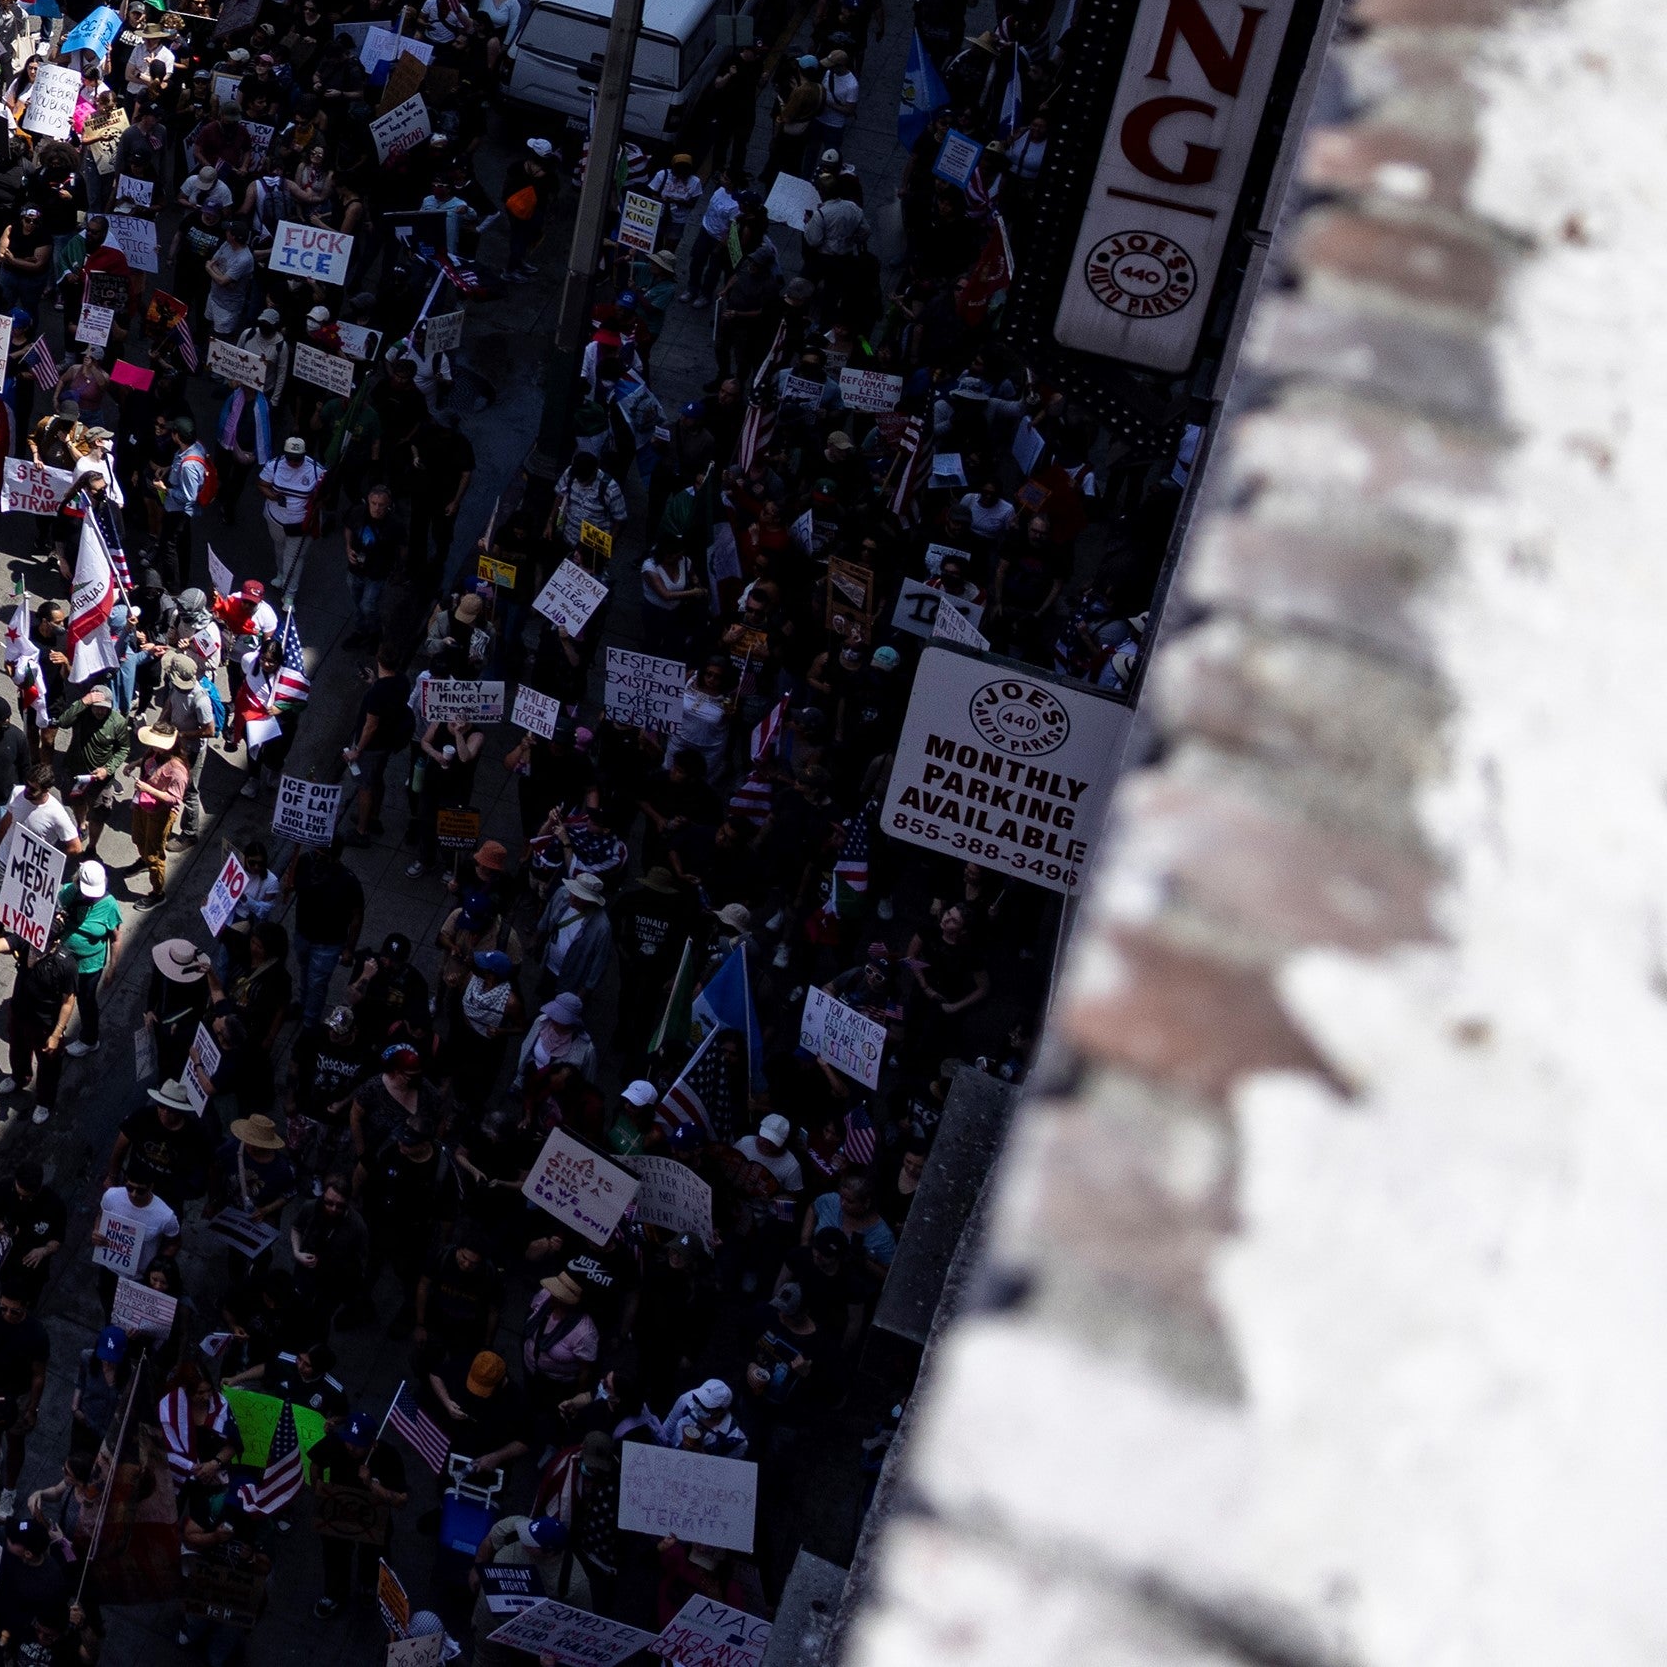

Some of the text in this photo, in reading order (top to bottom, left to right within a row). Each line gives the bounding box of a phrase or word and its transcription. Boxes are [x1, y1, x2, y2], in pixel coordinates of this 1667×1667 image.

[628, 195, 658, 213] NOT
[625, 213, 655, 230] KING
[284, 226, 345, 254] FUCK
[620, 234, 652, 251] MORON
[1109, 232, 1186, 271] JOE'S
[282, 247, 331, 274] ICE
[1120, 263, 1161, 283] 440
[841, 377, 902, 394] REFORMATION
[17, 463, 50, 486] SEE
[9, 491, 61, 514] STRANG
[32, 482, 56, 499] NO
[608, 648, 685, 677] RESPECT
[605, 672, 685, 699] EXISTENCE
[618, 693, 669, 716] EXPECT
[604, 705, 684, 734] RESISTANCE
[1002, 712, 1037, 731] 440
[924, 734, 1089, 802] MONTHLY
[922, 763, 1076, 830] PARKING
[898, 786, 1087, 864] AVAILABLE
[19, 831, 51, 864] THE
[892, 812, 1079, 887] 855-388-3496
[9, 858, 57, 901] MEDIA
[1, 909, 47, 952] LYING
[101, 1248, 132, 1270] 1776
[484, 1566, 532, 1581] IMMIGRANT
